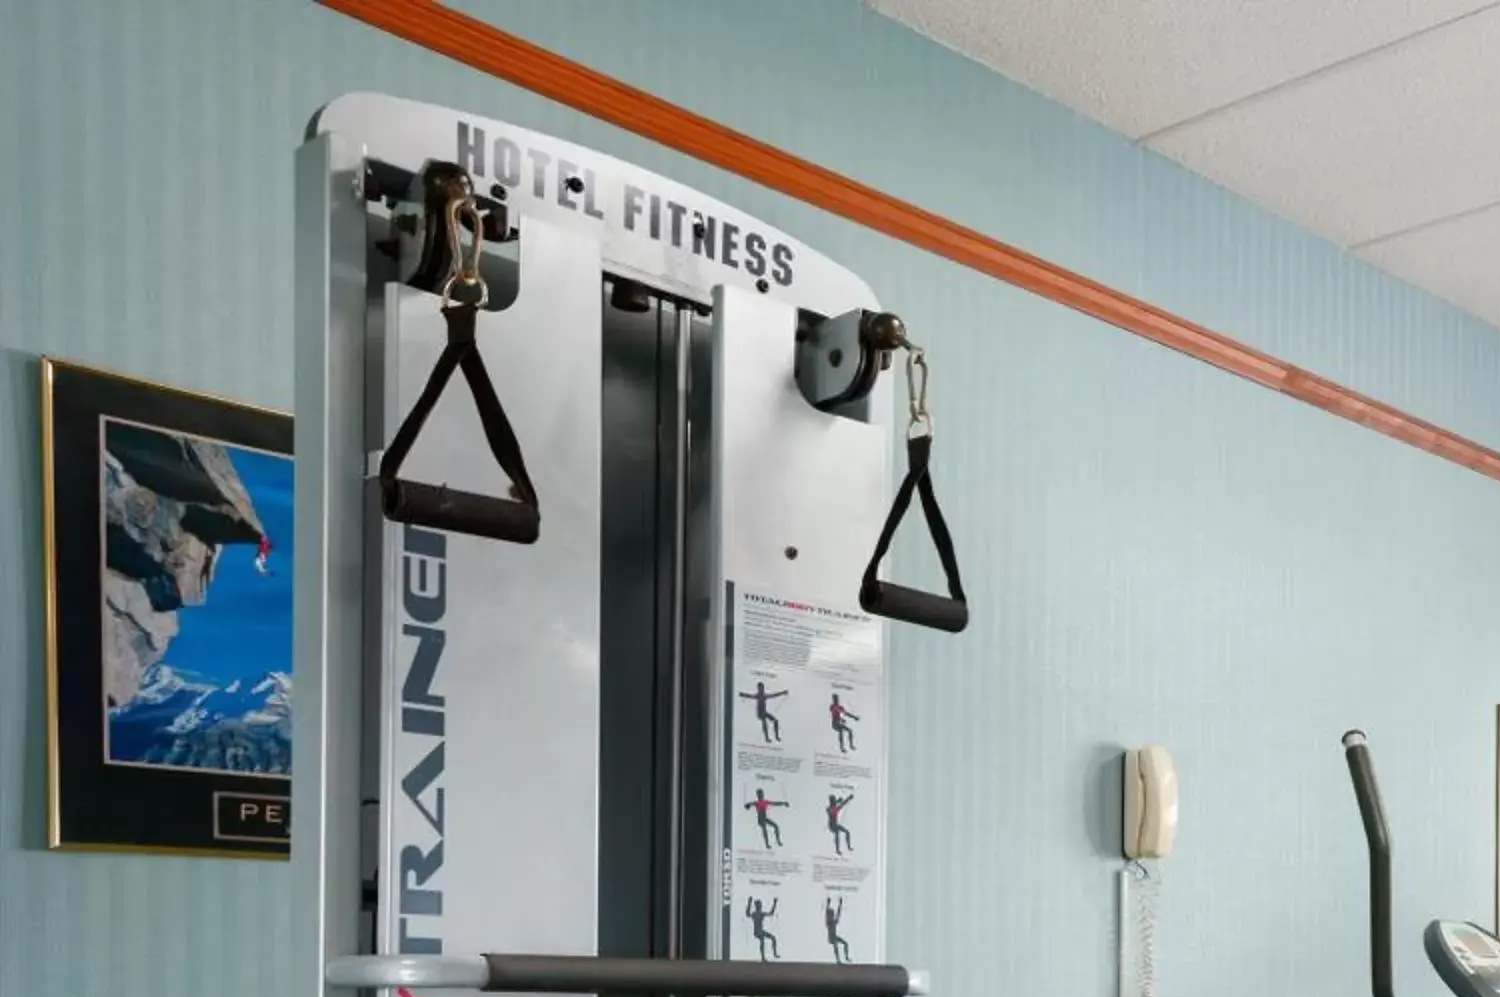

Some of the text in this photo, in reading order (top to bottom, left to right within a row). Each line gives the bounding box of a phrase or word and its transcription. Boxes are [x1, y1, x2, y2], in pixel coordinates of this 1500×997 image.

[457, 121, 793, 287] HOTEL FITNESS
[241, 803, 283, 823] PE
